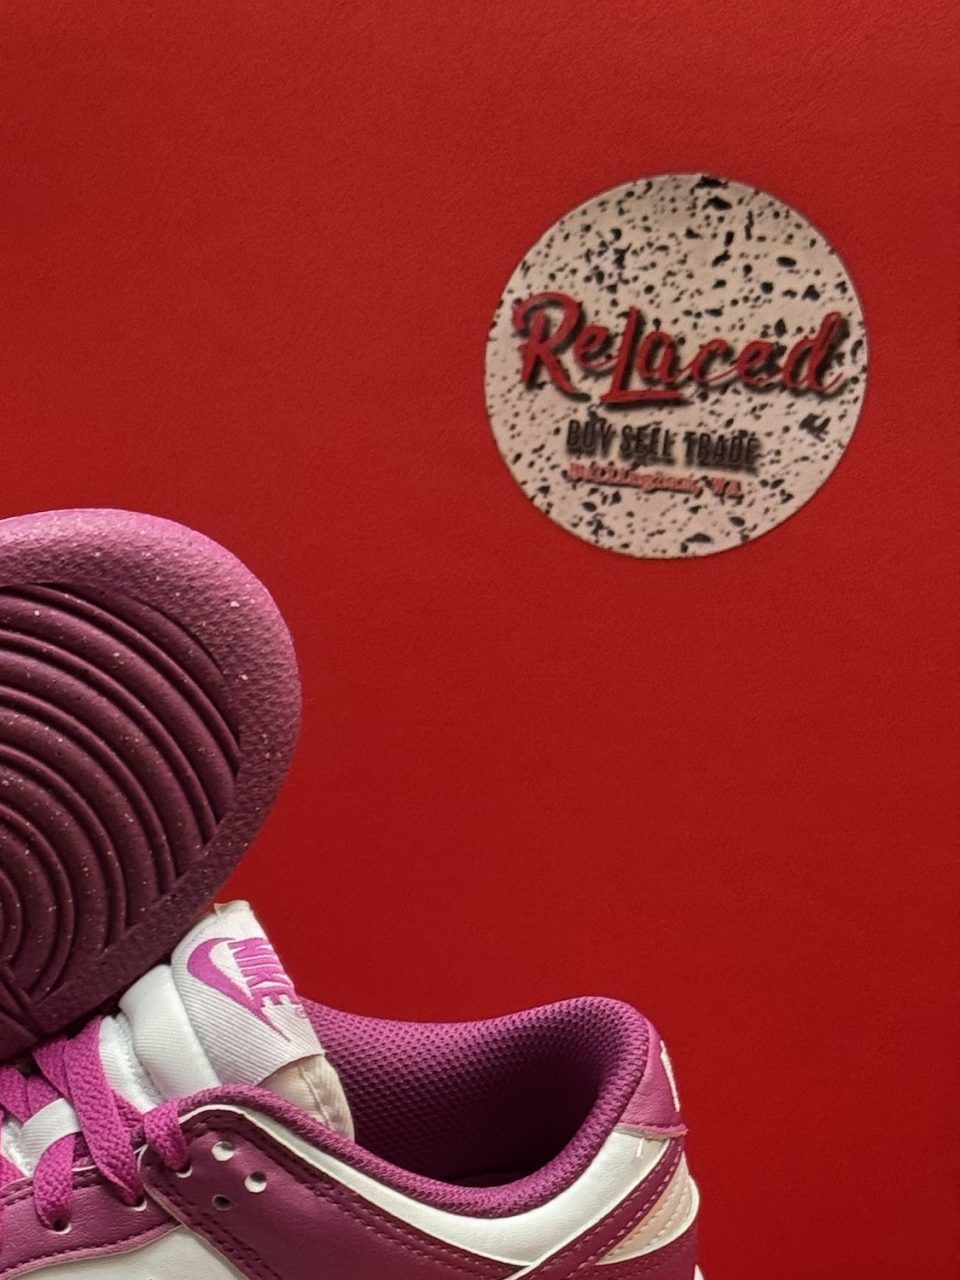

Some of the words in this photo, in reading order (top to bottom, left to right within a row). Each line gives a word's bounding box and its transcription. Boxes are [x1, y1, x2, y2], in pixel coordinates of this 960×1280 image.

[512, 291, 847, 406] ReLaced
[566, 418, 615, 456] BUY
[620, 424, 677, 465] SELL
[683, 430, 761, 474] TRADE
[227, 936, 303, 1009] NIKE
